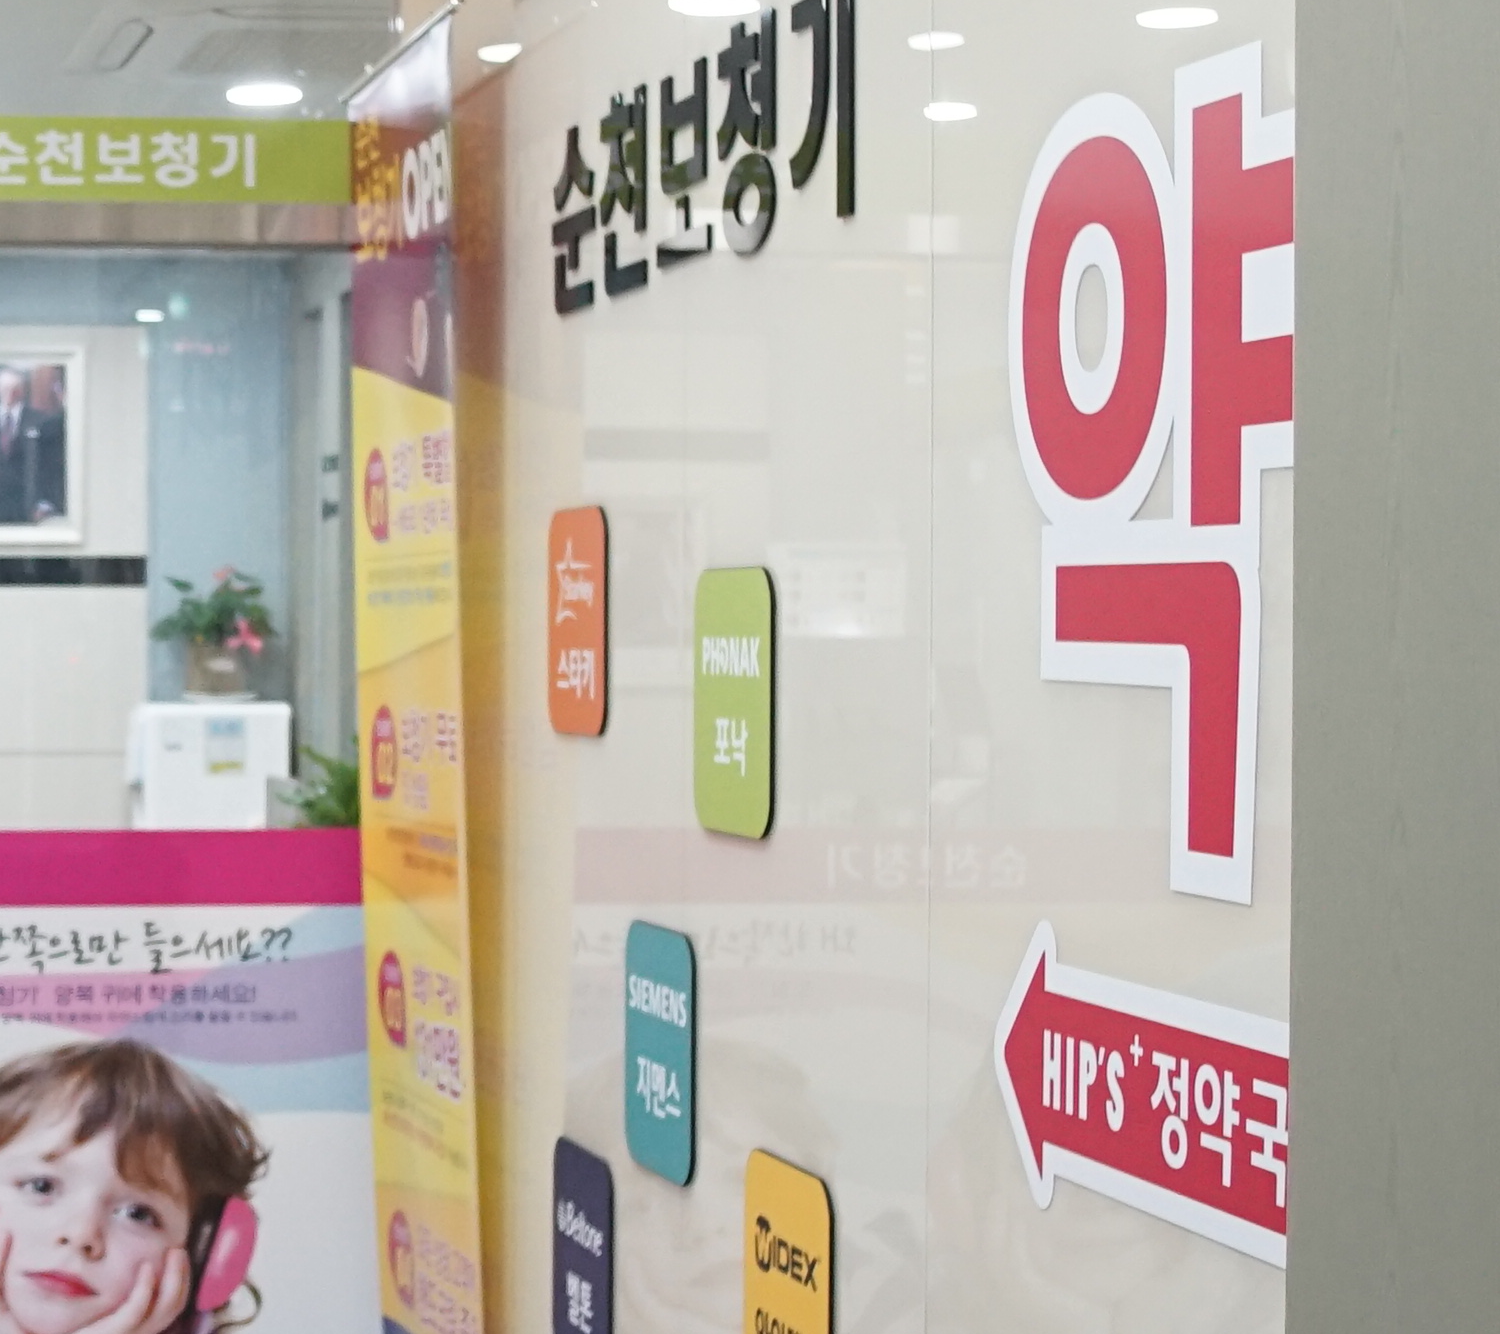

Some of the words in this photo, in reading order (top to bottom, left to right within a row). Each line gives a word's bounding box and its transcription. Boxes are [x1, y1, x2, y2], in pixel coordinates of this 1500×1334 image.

[556, 649, 596, 701] 스타키
[713, 717, 748, 778] 포낙
[143, 920, 294, 975] 들으세요??
[629, 974, 687, 1028] SIEMENS
[637, 1055, 681, 1119] 지멘스
[1150, 1050, 1289, 1209] 정약국
[755, 1214, 819, 1294] WIDEX
